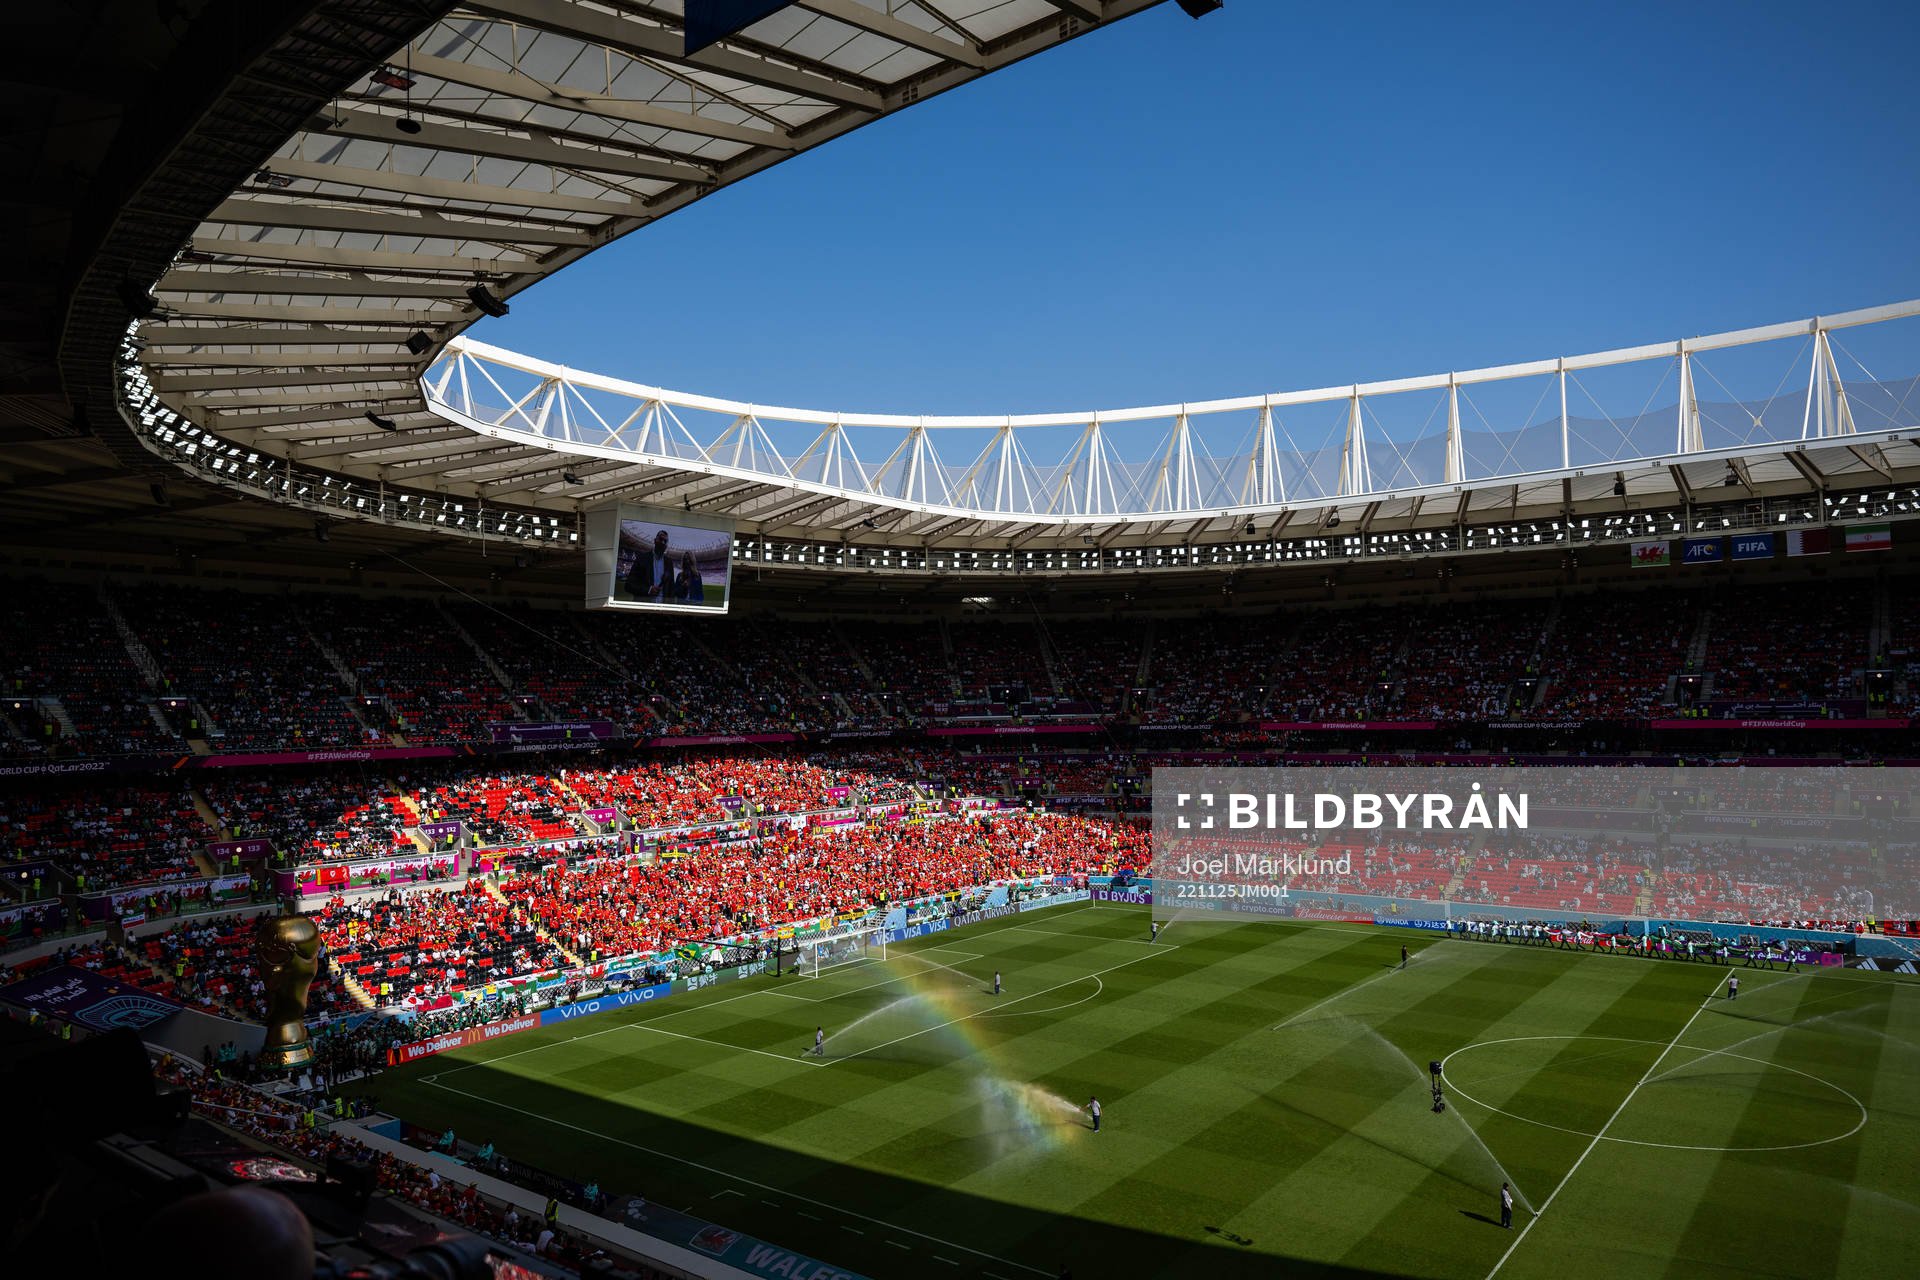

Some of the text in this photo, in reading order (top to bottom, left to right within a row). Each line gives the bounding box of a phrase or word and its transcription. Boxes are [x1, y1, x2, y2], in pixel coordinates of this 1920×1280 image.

[1688, 544, 1713, 556] AFC
[1737, 542, 1767, 553] FIFA
[307, 752, 371, 761] #FIFAWorldCup
[23, 765, 40, 774] CUP
[216, 844, 261, 856] 134 133
[1111, 891, 1146, 904] BYJU'S
[1161, 896, 1215, 911] Hisense
[953, 903, 1016, 927] QATAR AIRWAYS
[1240, 904, 1286, 915] crypto.com
[1296, 907, 1348, 921] Budweiser
[929, 920, 947, 934] VISA
[1385, 918, 1409, 926] WANDA
[903, 926, 922, 939] VISA
[618, 988, 655, 1005] vivo
[561, 1001, 601, 1019] vivo
[484, 1018, 535, 1038] We Deliver
[407, 1036, 463, 1058] We Deliver
